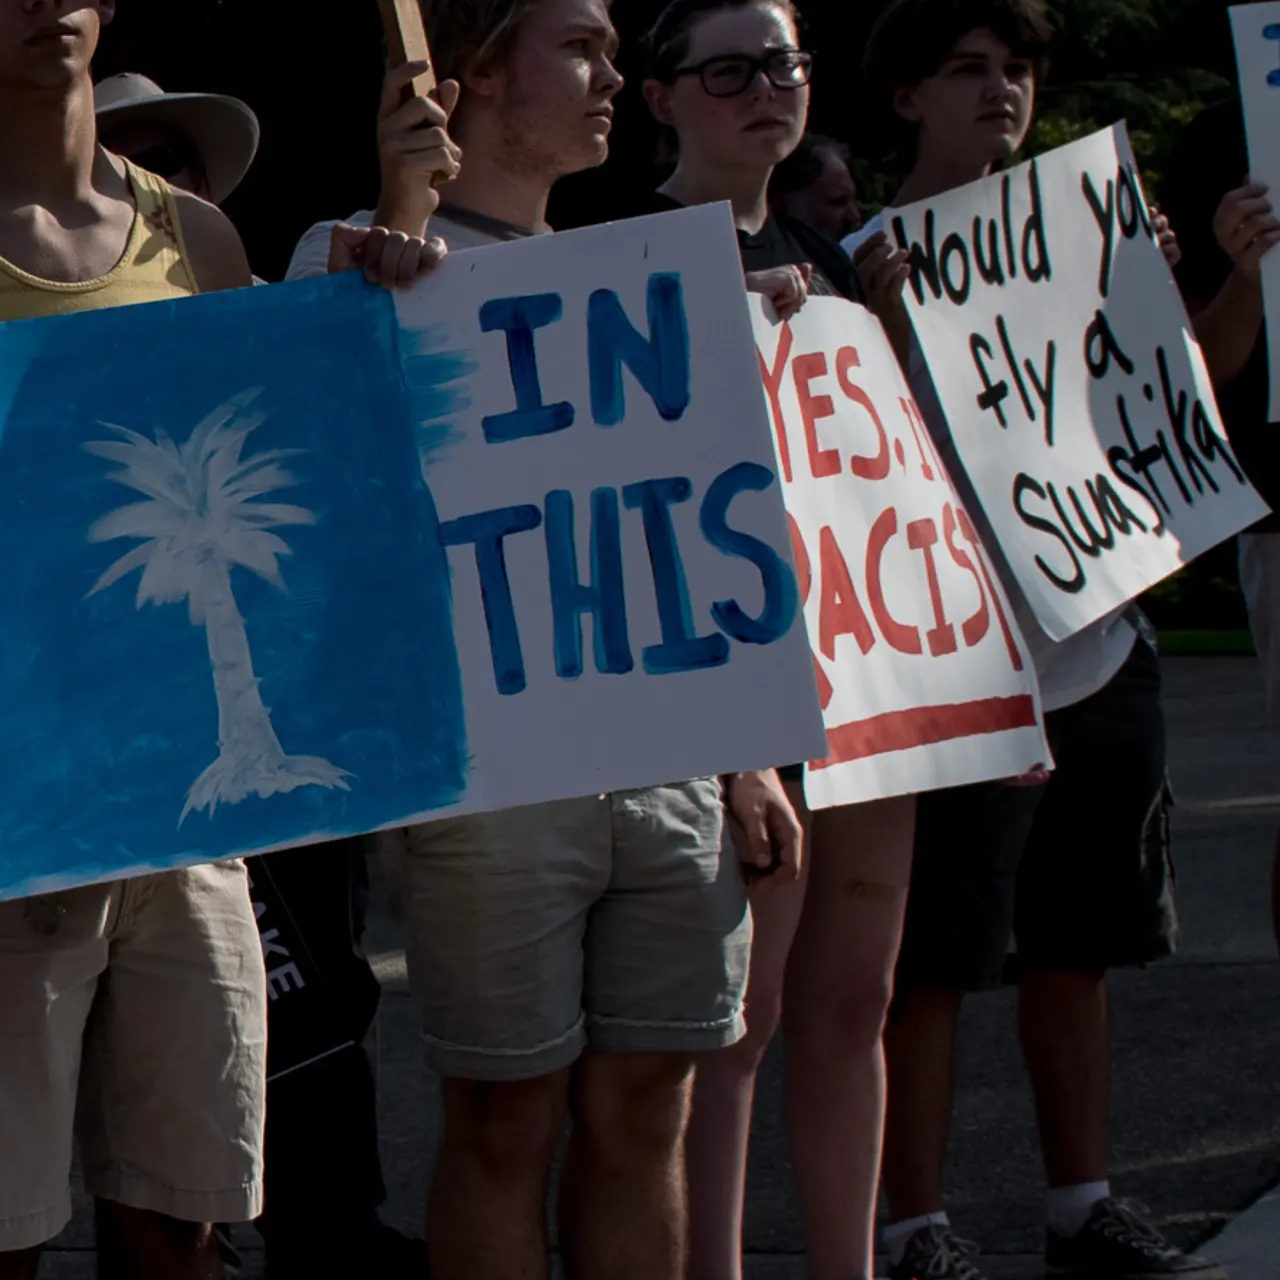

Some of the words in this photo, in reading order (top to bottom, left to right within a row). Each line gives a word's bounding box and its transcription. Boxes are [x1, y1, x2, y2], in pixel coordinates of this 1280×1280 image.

[893, 157, 1052, 305] Would
[477, 271, 692, 444] IN
[756, 320, 906, 483] YES.
[969, 314, 1055, 446] fly
[1084, 308, 1135, 379] a
[1012, 346, 1246, 594] Swastika
[442, 460, 800, 698] THIS
